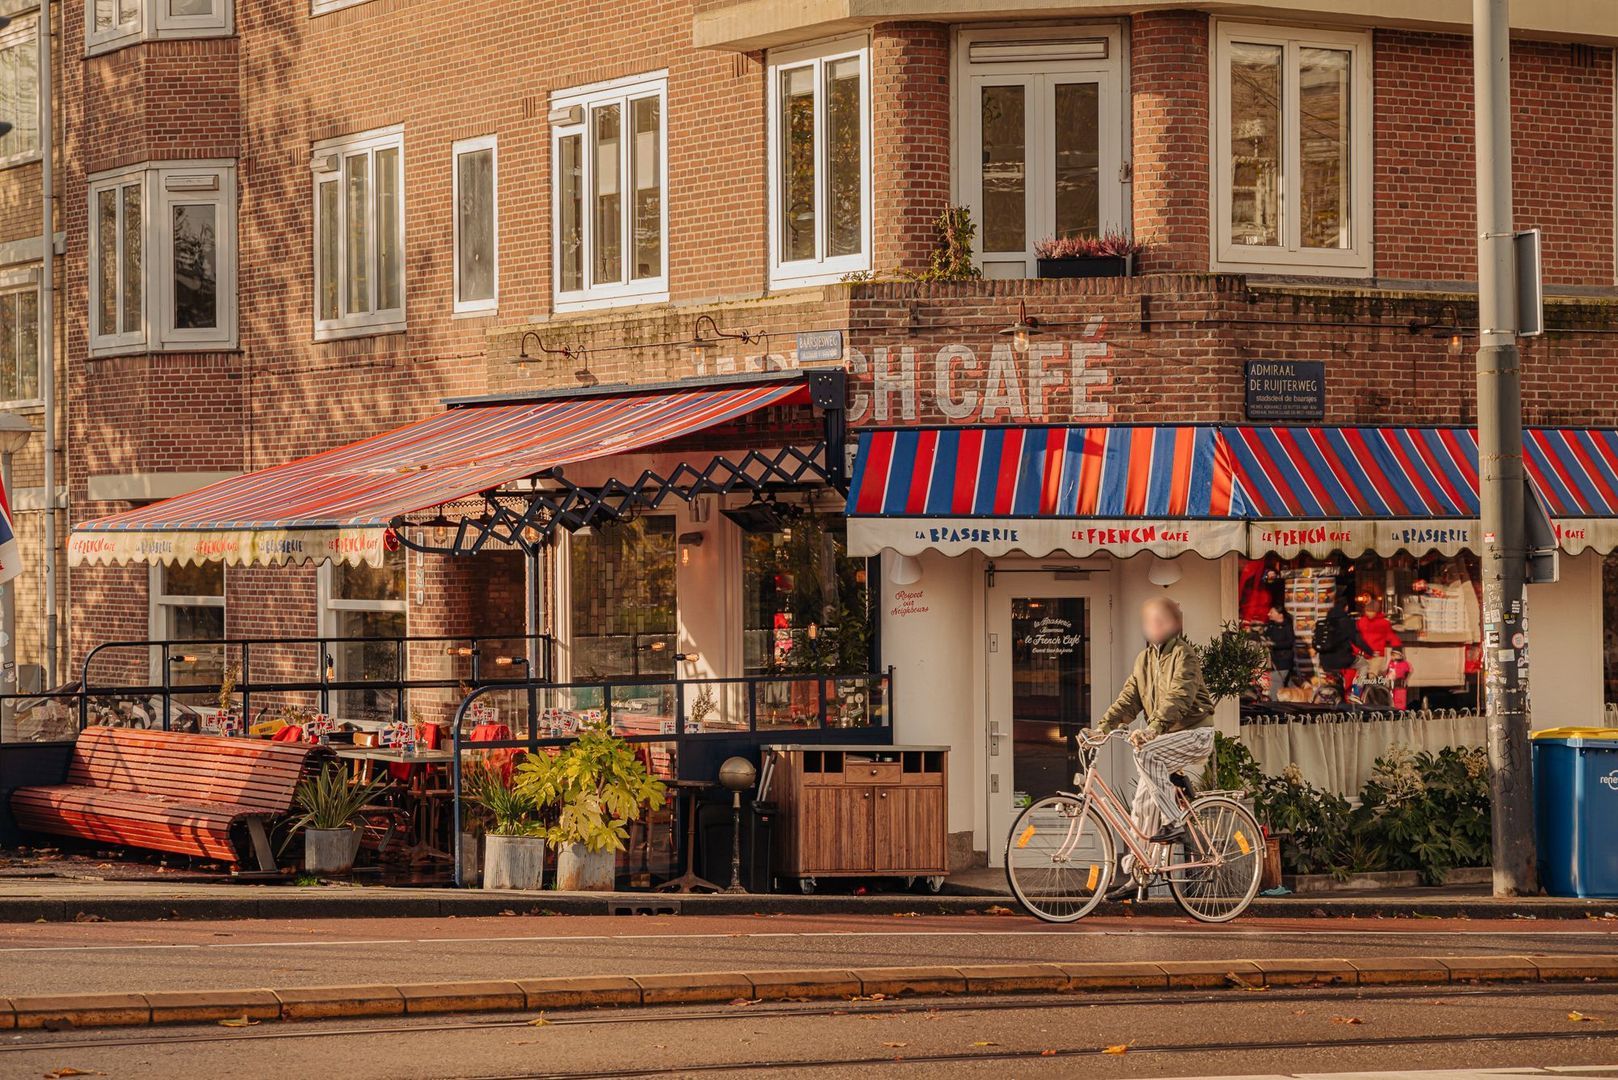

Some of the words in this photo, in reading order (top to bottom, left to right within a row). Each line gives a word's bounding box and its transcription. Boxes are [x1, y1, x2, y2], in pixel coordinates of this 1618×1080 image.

[935, 317, 1110, 421] CAFÉ
[1250, 364, 1295, 376] ADMIRAAL
[1250, 379, 1261, 391] DE
[1264, 380, 1317, 394] RUIJTERWEG
[915, 531, 925, 539] LA
[930, 527, 1019, 542] BRASSERIE
[1072, 531, 1083, 540] LE
[1087, 526, 1155, 544] FRENCH
[1161, 530, 1189, 541] CAFÉ
[1262, 532, 1272, 541] LE
[1274, 526, 1326, 546] FRENCH
[1329, 530, 1352, 541] CAFÉ
[1391, 532, 1399, 540] LA
[1402, 528, 1468, 543] BRASSERIE
[1565, 528, 1585, 539] CAFÉ
[895, 591, 923, 600] Respect
[1025, 635, 1032, 644] le
[1033, 634, 1061, 646] French
[1063, 635, 1080, 646] Café
